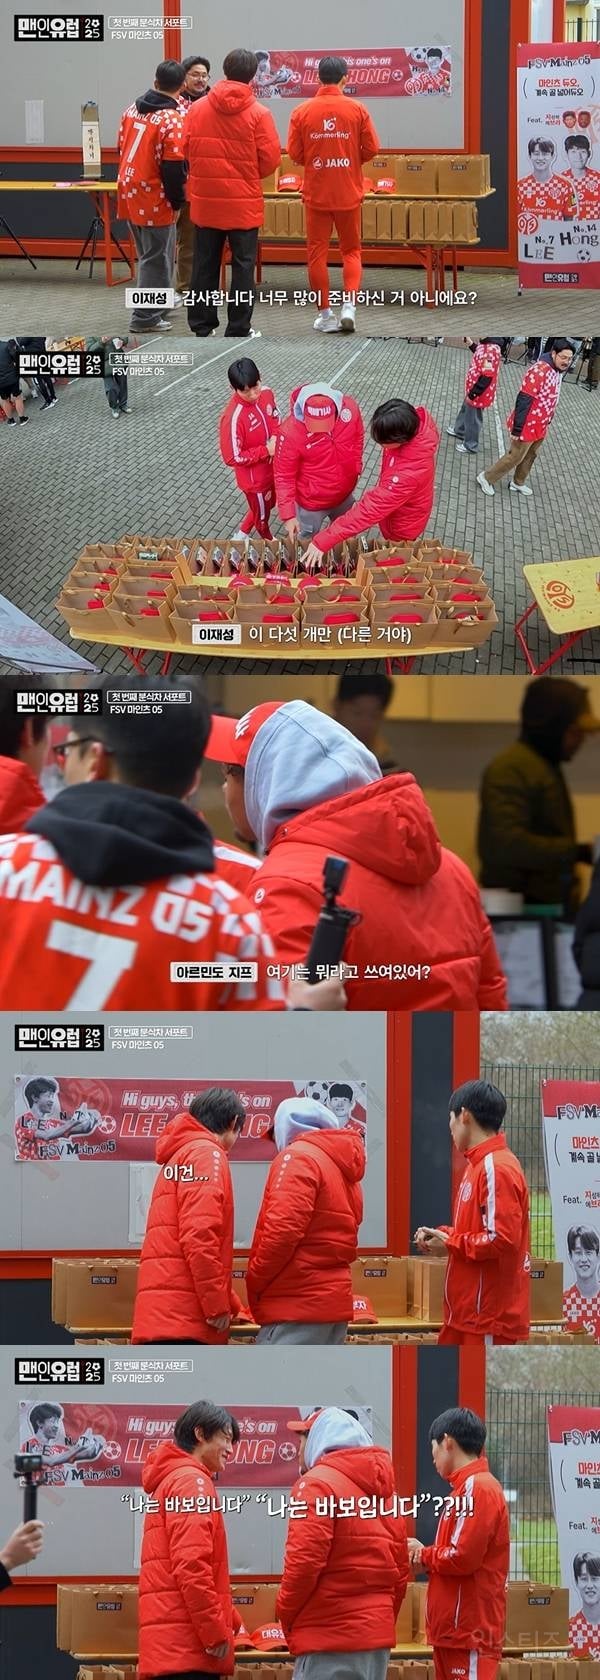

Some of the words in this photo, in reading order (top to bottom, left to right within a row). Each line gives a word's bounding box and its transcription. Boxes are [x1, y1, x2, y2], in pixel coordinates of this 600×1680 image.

[538, 79, 561, 88] 마인츠
[150, 114, 162, 126] 05
[126, 121, 147, 164] 7
[325, 157, 350, 168] JAKO
[125, 166, 136, 177] LEE
[560, 231, 599, 247] Hong
[0, 859, 146, 926] MAINZ
[151, 890, 214, 943] 05
[45, 918, 139, 1009] 7
[123, 1092, 138, 1106] Hi
[139, 1094, 180, 1110] guys,
[252, 1096, 271, 1107] on
[572, 1136, 600, 1149] 마인츠
[569, 1152, 585, 1163] 계속
[562, 1195, 581, 1204] Feat.
[128, 1417, 143, 1431] Hi
[258, 1421, 277, 1433] on
[575, 1477, 591, 1489] 계속
[568, 1521, 587, 1530] Feat.
